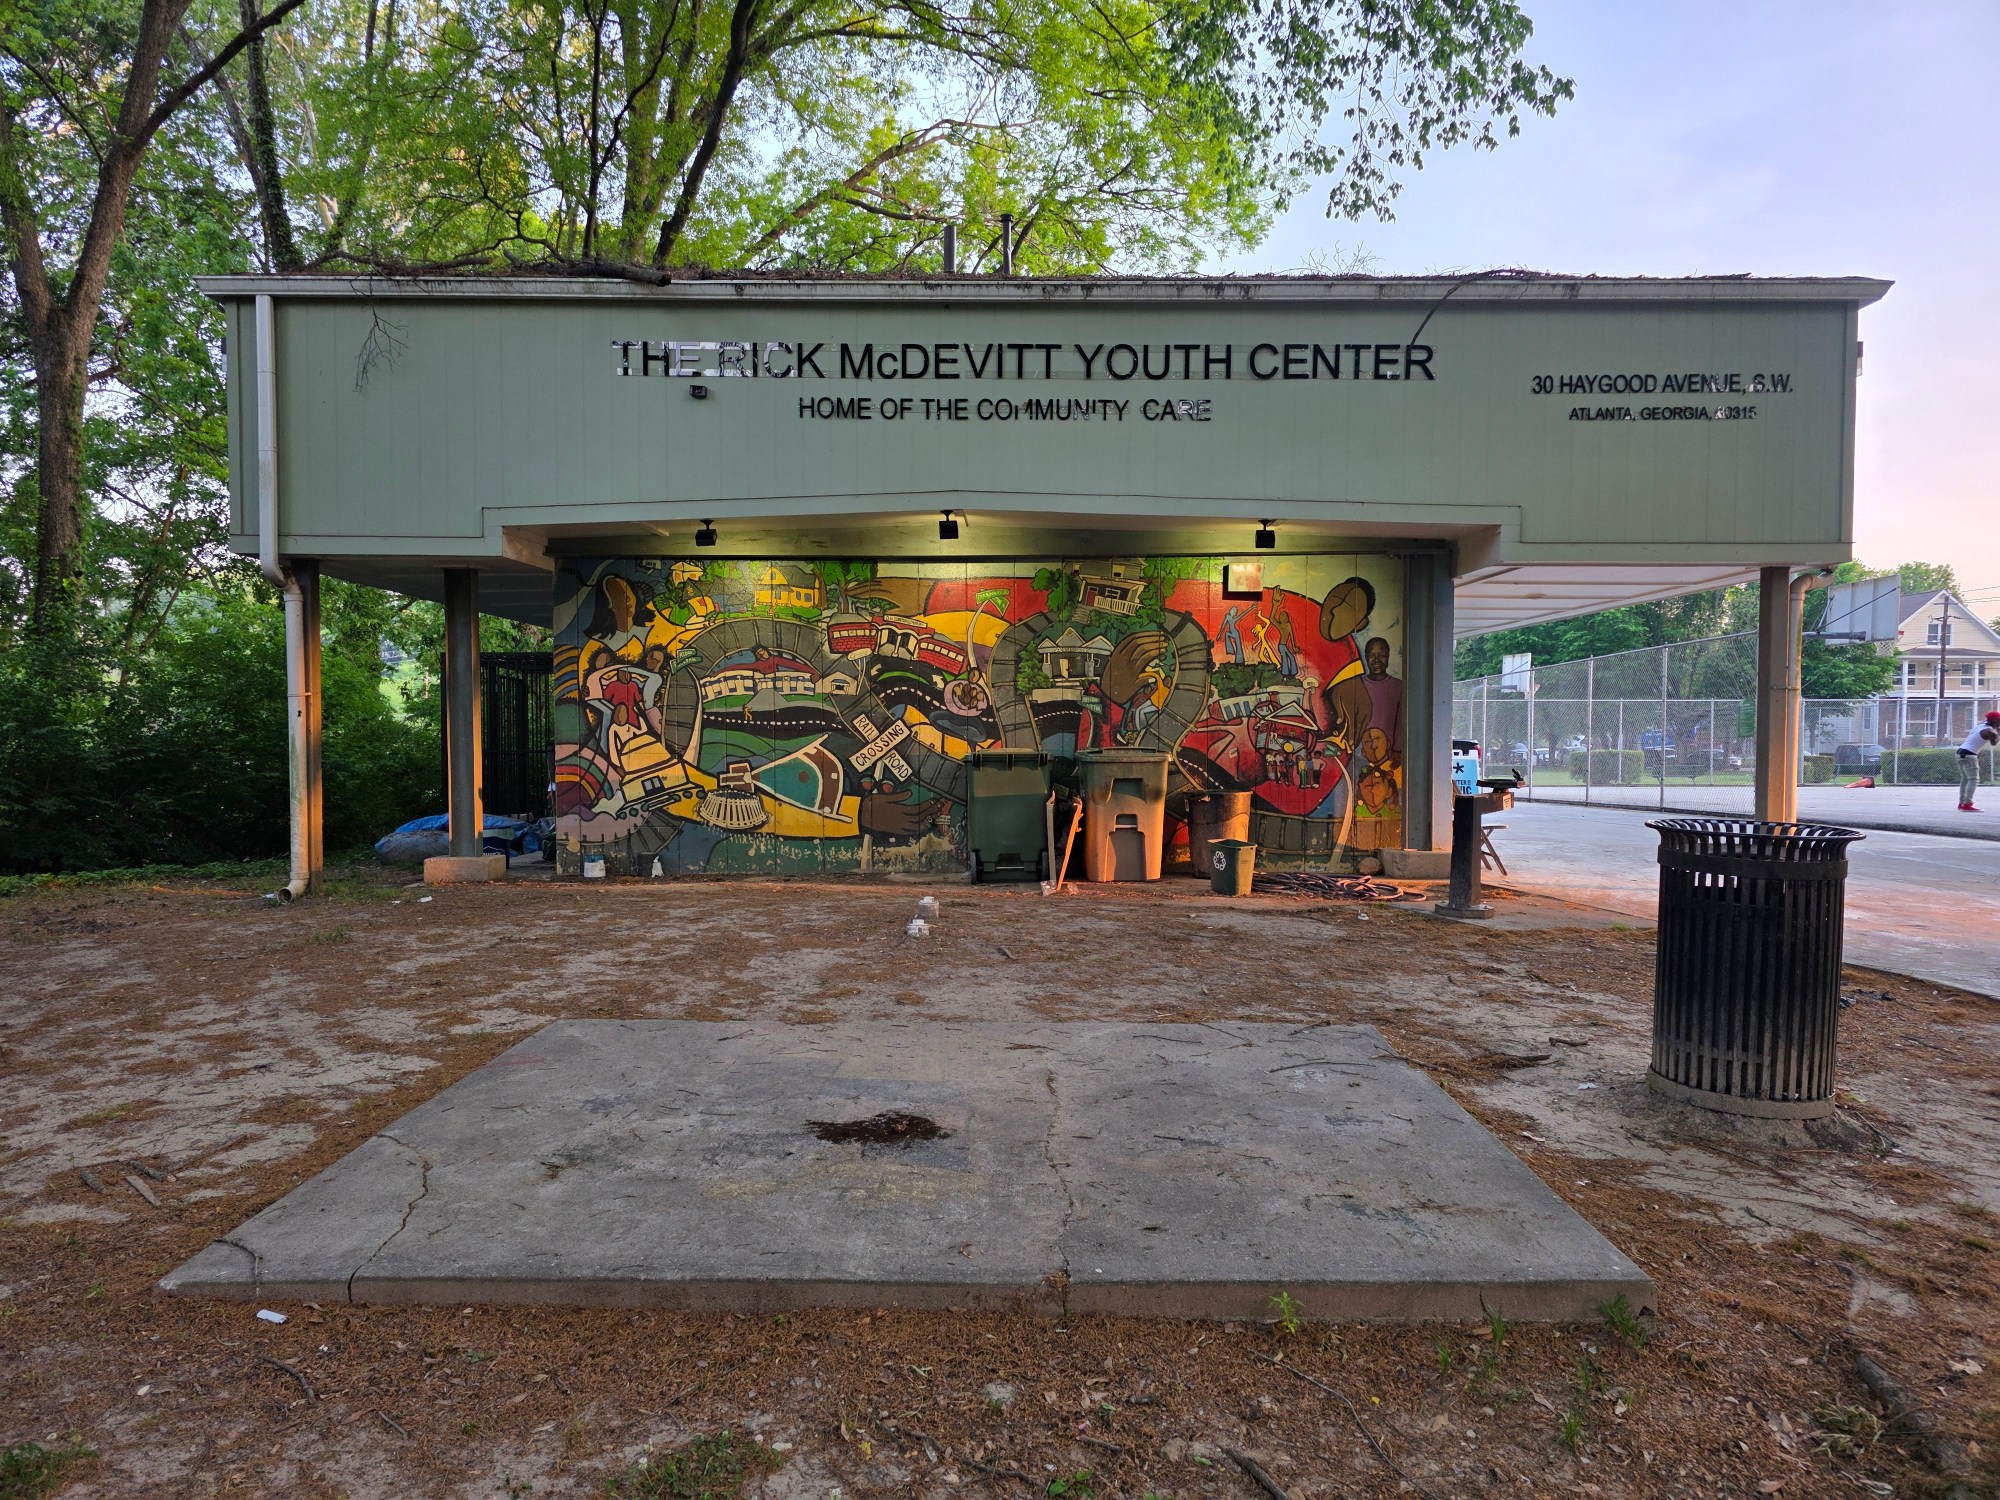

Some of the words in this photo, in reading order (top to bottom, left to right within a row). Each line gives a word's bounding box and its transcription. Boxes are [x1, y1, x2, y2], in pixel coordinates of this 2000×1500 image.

[612, 341, 701, 377] THE
[719, 341, 826, 378] RICK
[840, 342, 1062, 379] McDEVITT
[1074, 343, 1232, 380] YOUTH
[1249, 343, 1435, 380] CENTER
[1532, 375, 1554, 394] 30
[1559, 374, 1657, 394] HAYGOOD
[1661, 373, 1746, 395] AVENUE,
[1753, 373, 1793, 393] S.W.
[799, 397, 872, 420] HOME
[880, 398, 914, 420] OF
[920, 398, 969, 421] THE
[1143, 398, 1211, 421] CARE
[1569, 406, 1636, 421] ATLANTA,
[1640, 406, 1712, 421] GEORGIA,
[855, 724, 905, 767] CROSSING
[855, 716, 875, 741] RAIL
[884, 752, 909, 779] ROAD
